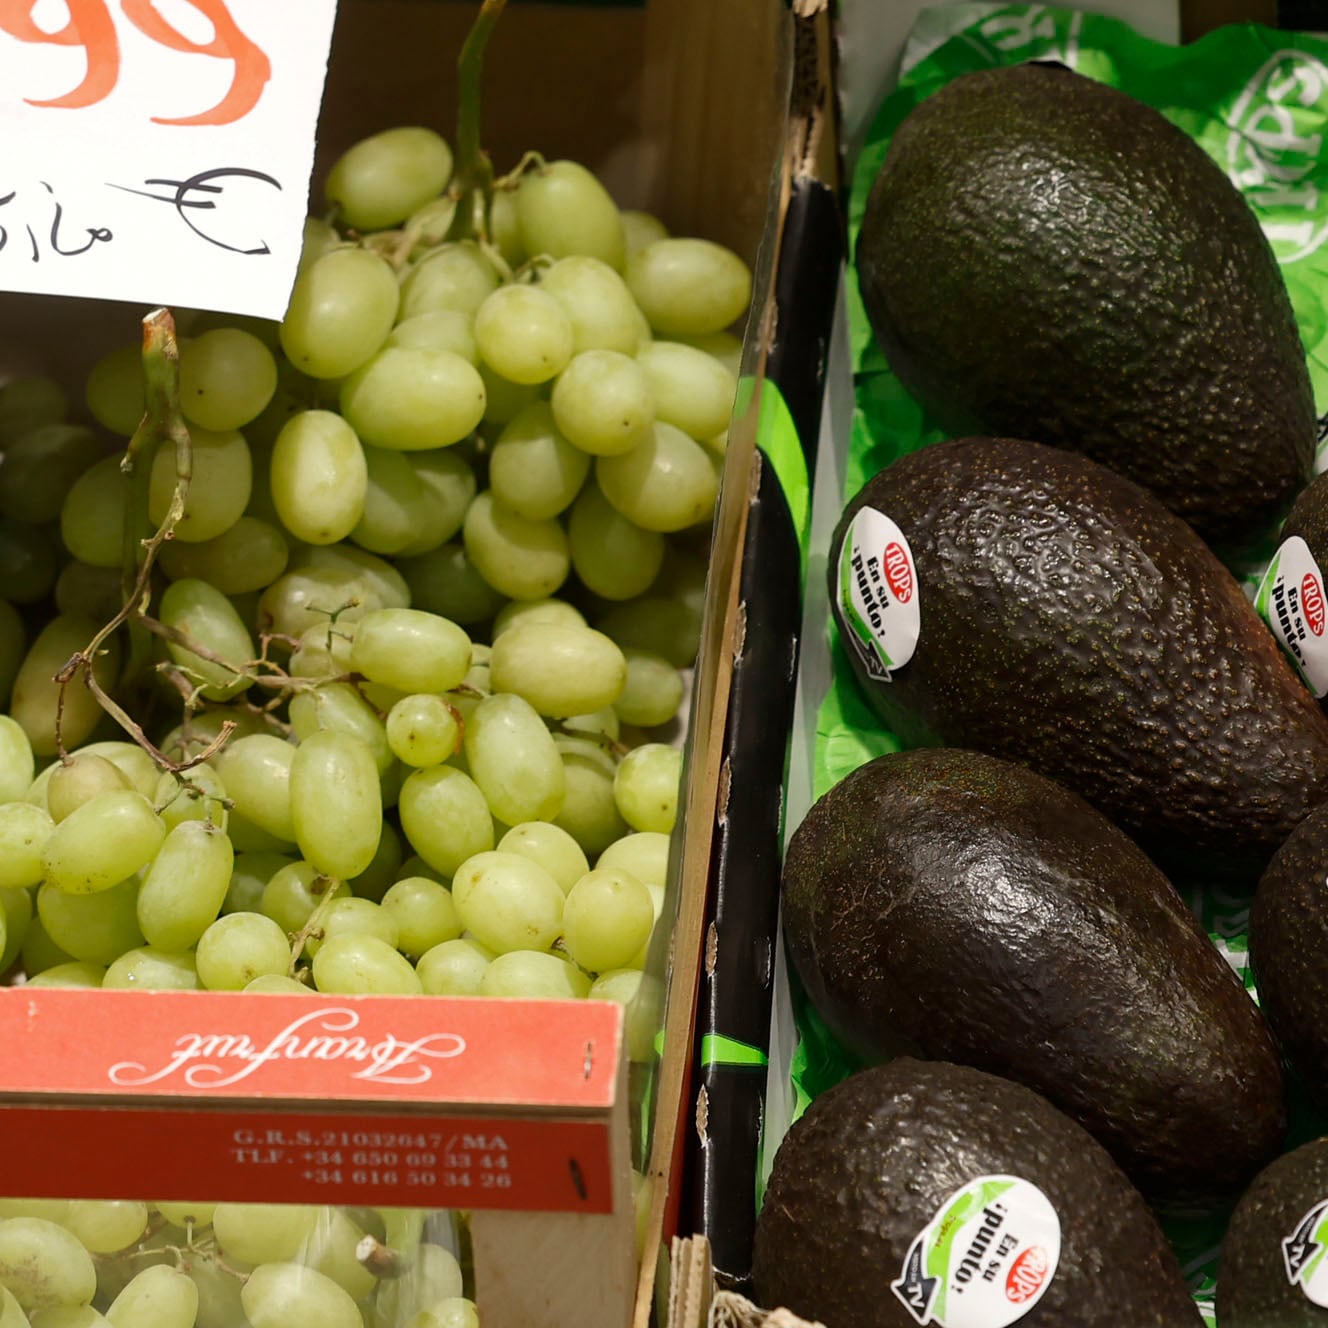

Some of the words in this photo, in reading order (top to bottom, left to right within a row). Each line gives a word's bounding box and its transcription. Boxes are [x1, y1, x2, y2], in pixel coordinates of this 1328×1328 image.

[104, 166, 283, 254] €
[866, 555, 881, 584] En
[875, 585, 890, 610] su
[885, 545, 912, 603] TROPS
[1287, 586, 1299, 614] En
[1294, 617, 1307, 642] su
[1303, 575, 1325, 637] TROPS
[107, 1006, 467, 1088] Aranfrut
[302, 1149, 344, 1166] +34
[302, 1169, 344, 1185] +34
[981, 1259, 1002, 1283] su
[995, 1233, 1020, 1258] En
